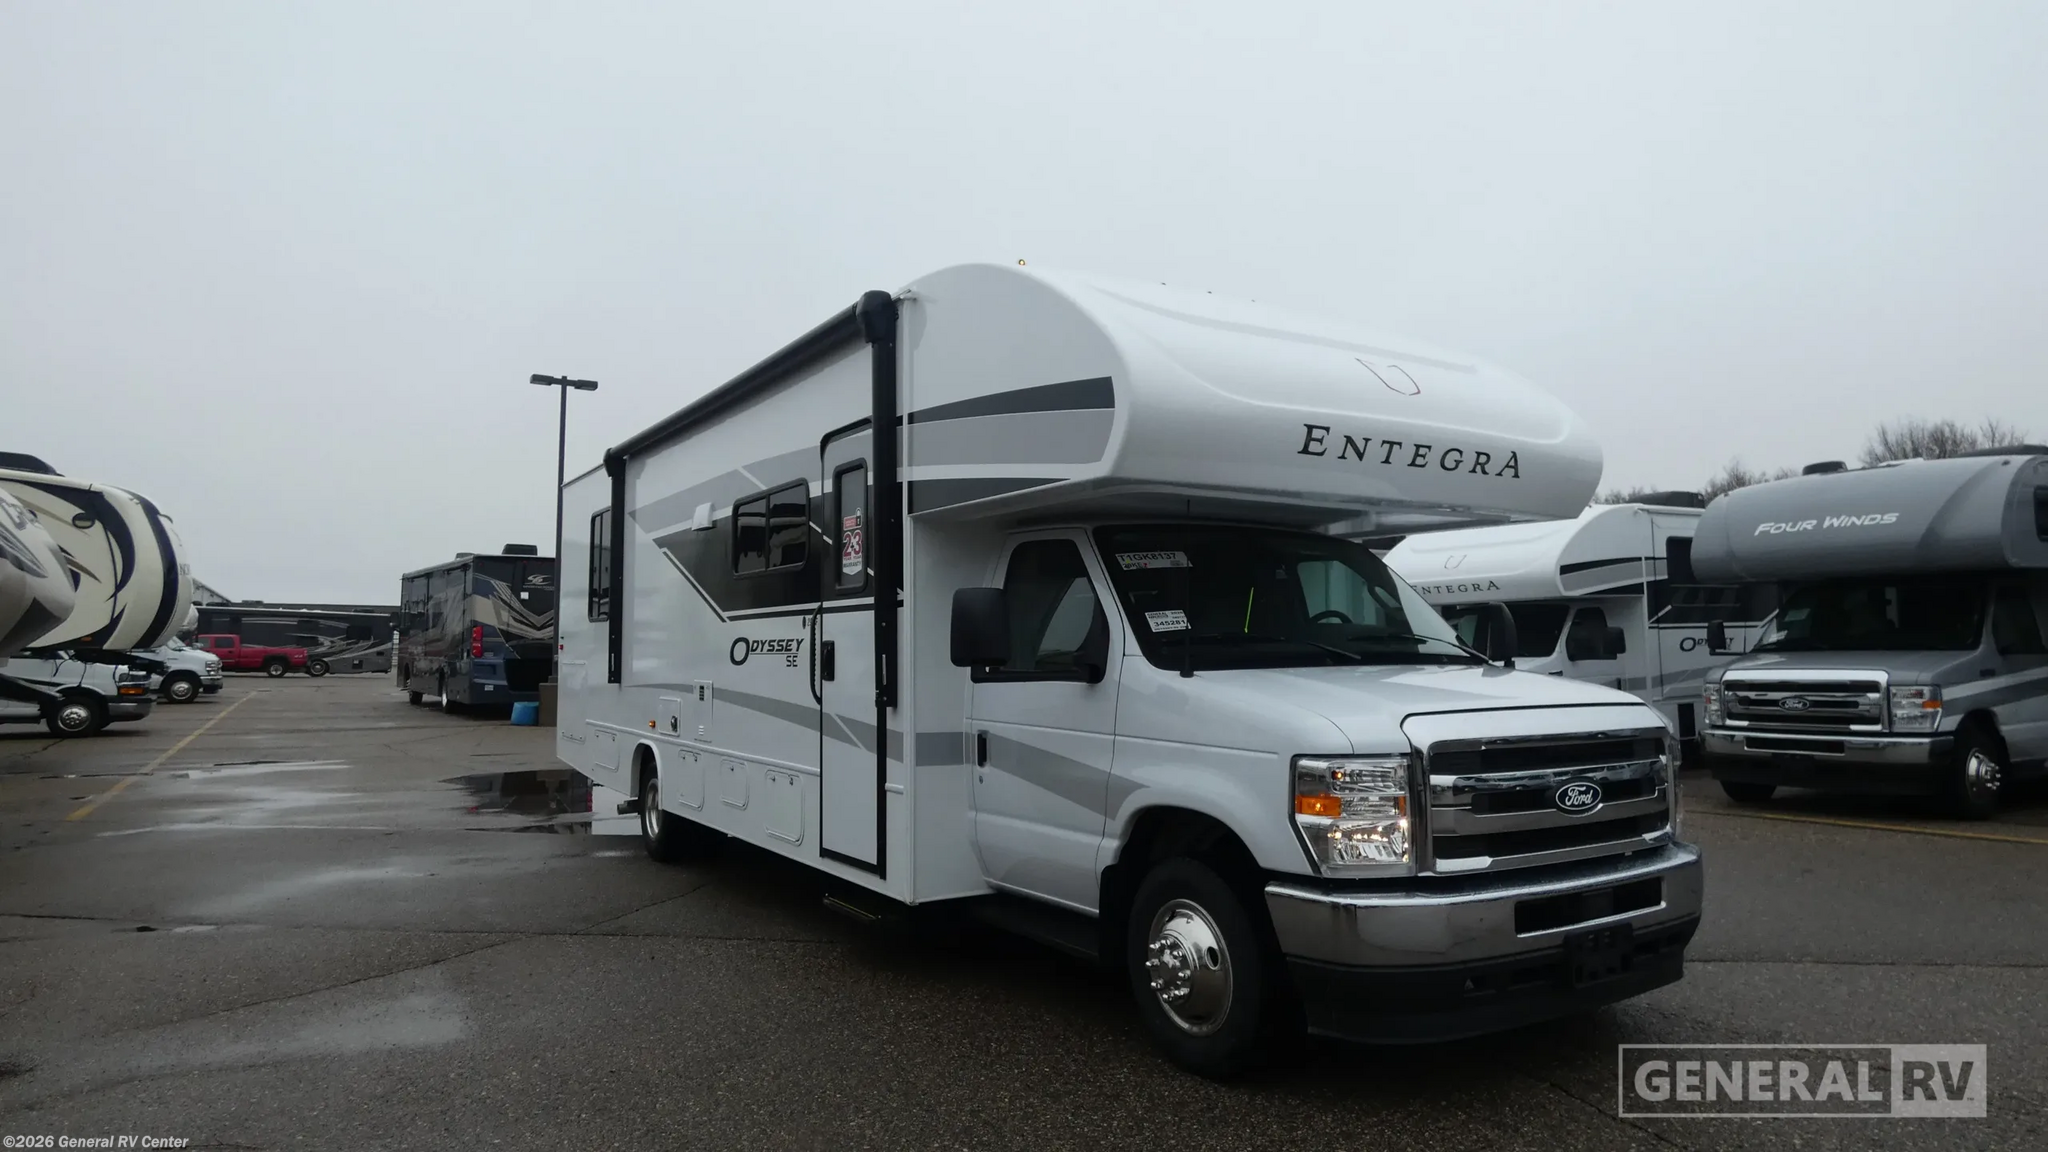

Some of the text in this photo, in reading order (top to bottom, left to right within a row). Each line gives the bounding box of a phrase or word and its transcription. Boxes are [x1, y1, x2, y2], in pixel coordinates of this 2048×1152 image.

[1297, 423, 1521, 479] ENTEGRA
[1754, 512, 1900, 537] FOUR WINDS
[1117, 552, 1177, 562] T1GK8137
[1153, 619, 1186, 628] 345281
[730, 637, 805, 666] ODYSSEY
[786, 655, 798, 667] SE
[1565, 786, 1593, 806] Ford
